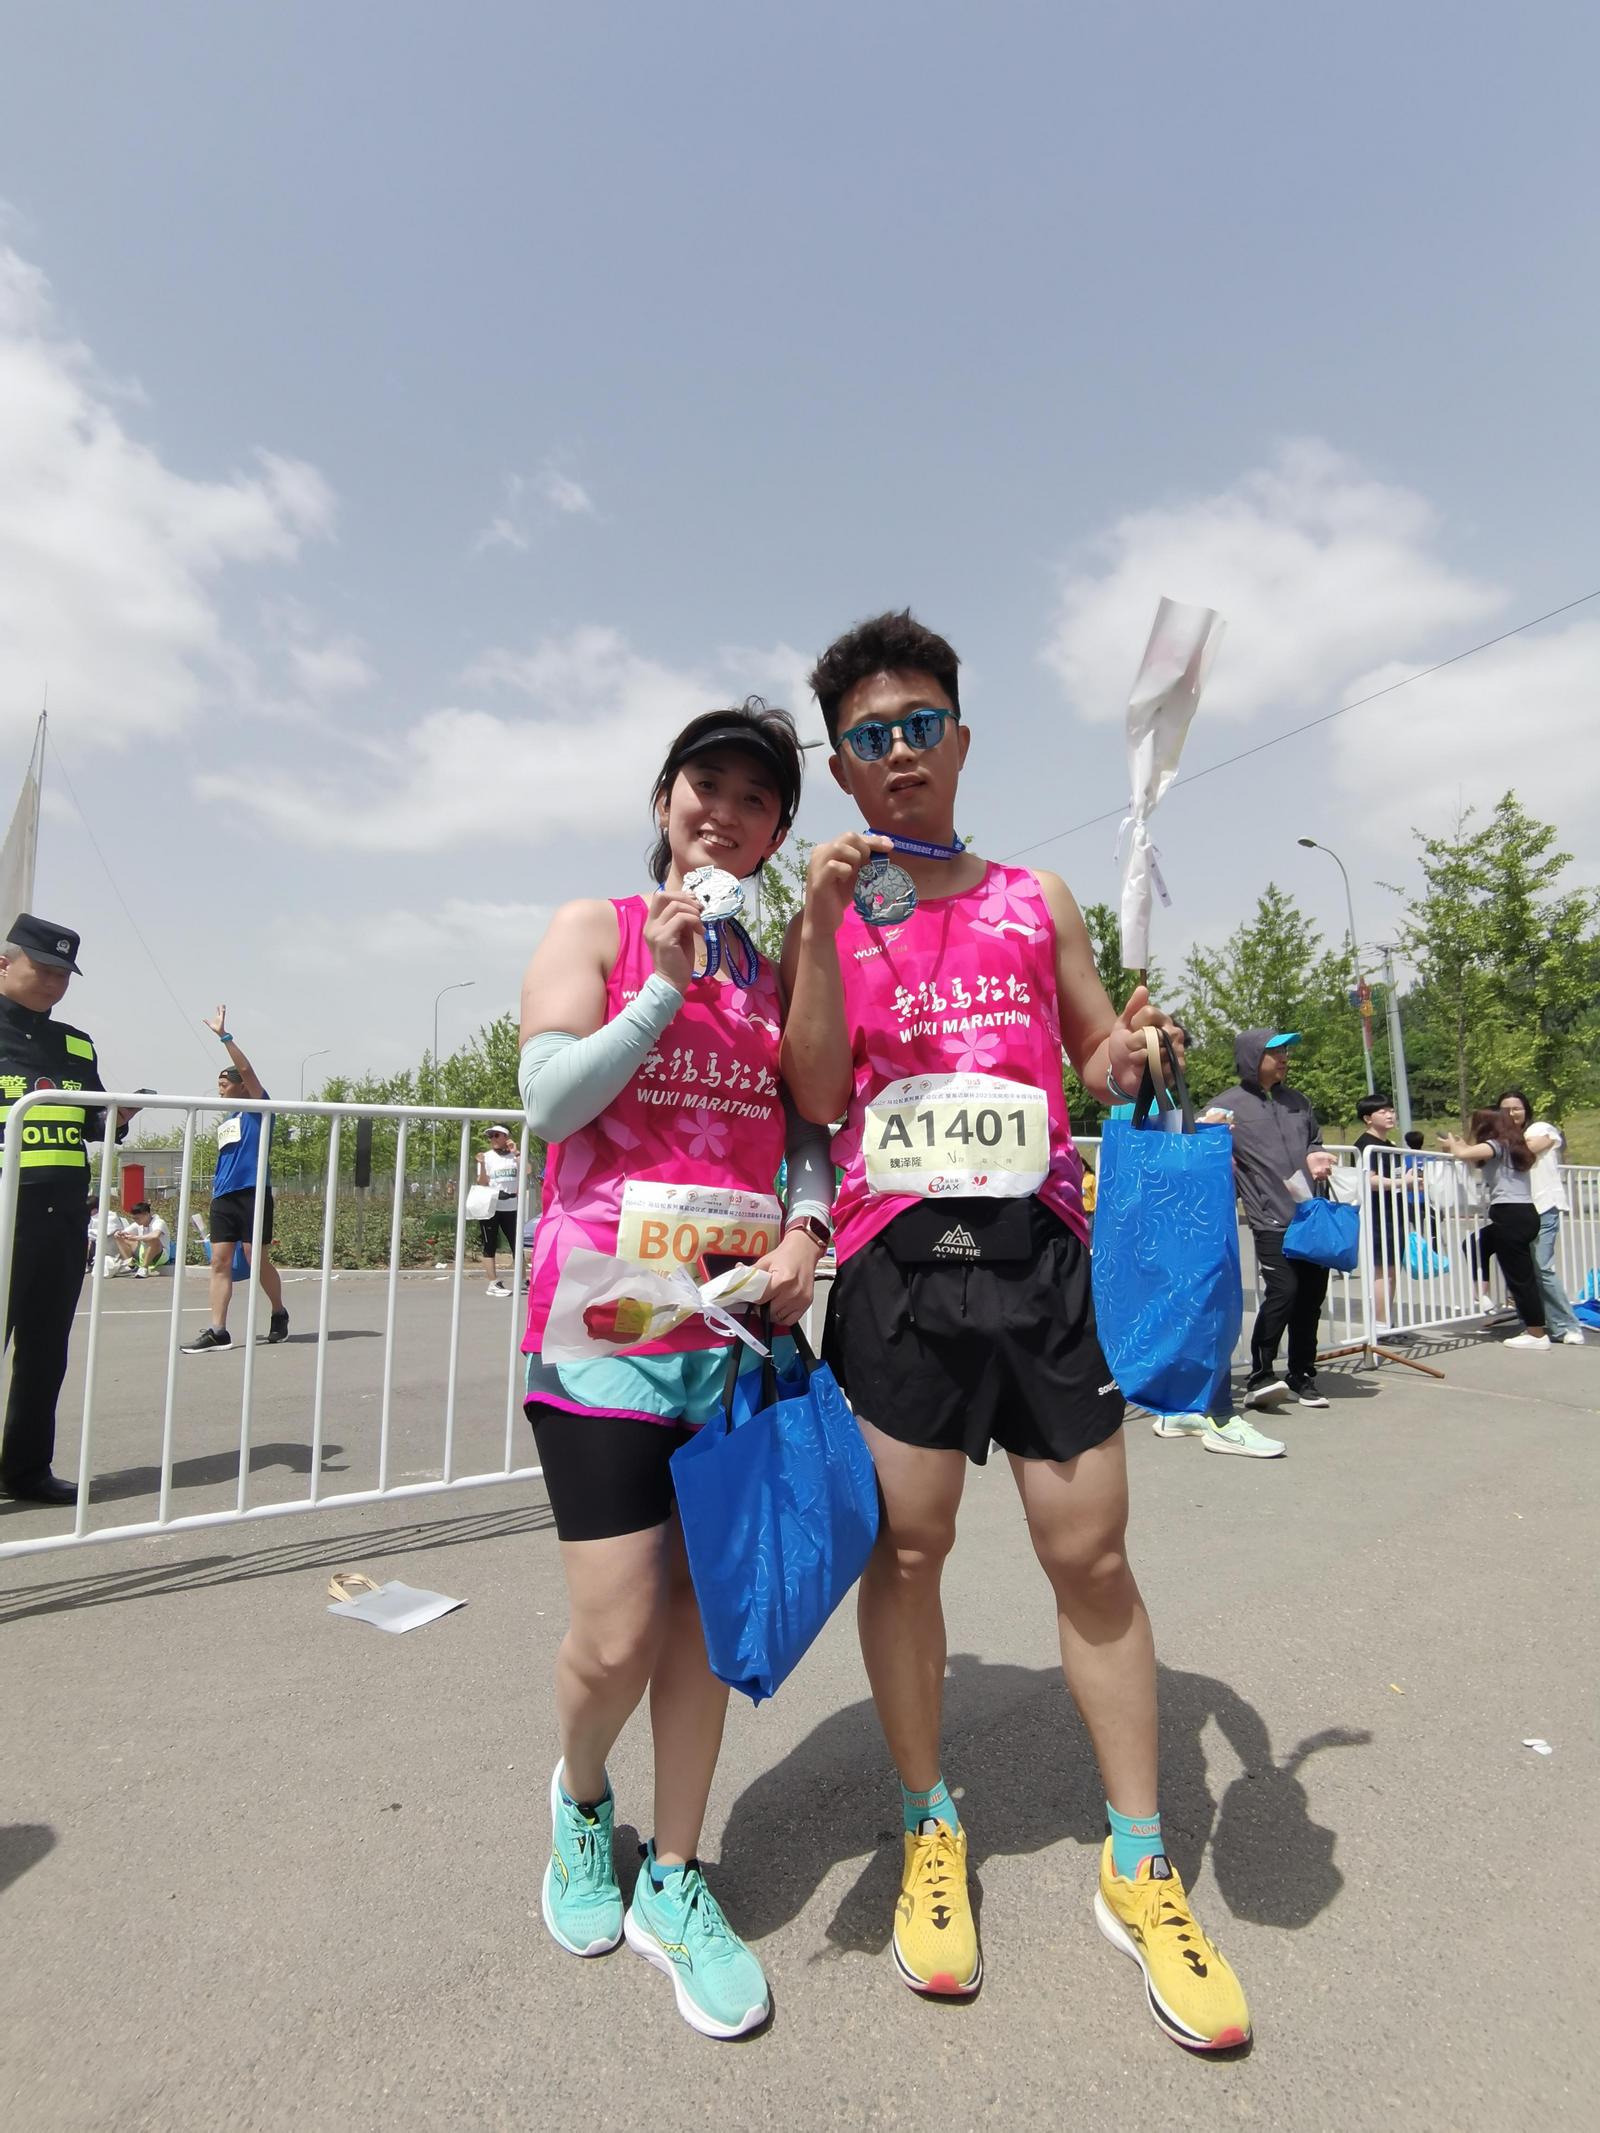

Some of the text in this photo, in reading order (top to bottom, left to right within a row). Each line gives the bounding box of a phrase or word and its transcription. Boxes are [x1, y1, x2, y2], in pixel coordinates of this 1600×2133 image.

[853, 945, 883, 960] WUXI
[899, 1010, 1031, 1044] WUXI MARATHON
[637, 1088, 772, 1120] WUXI MARATHON
[23, 1126, 82, 1145] OLIC
[878, 1109, 1027, 1150] A1401
[889, 1157, 922, 1169] 魏泽隆
[639, 1220, 769, 1263] B0330
